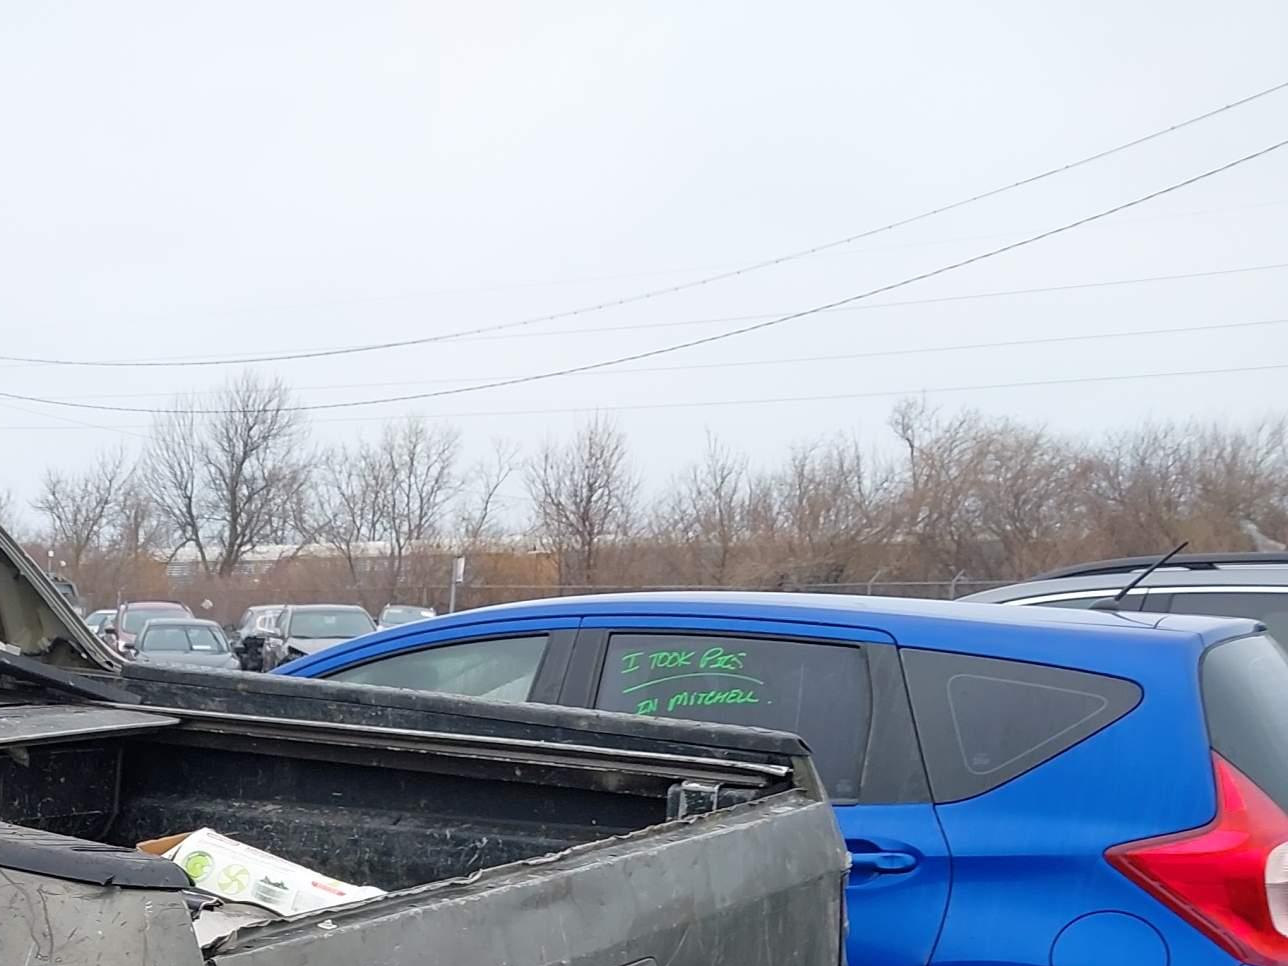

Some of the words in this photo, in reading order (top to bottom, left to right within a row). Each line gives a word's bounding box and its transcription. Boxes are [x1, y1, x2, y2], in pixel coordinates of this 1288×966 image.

[622, 652, 644, 674] I
[648, 650, 696, 670] TOOK
[636, 697, 658, 716] IN
